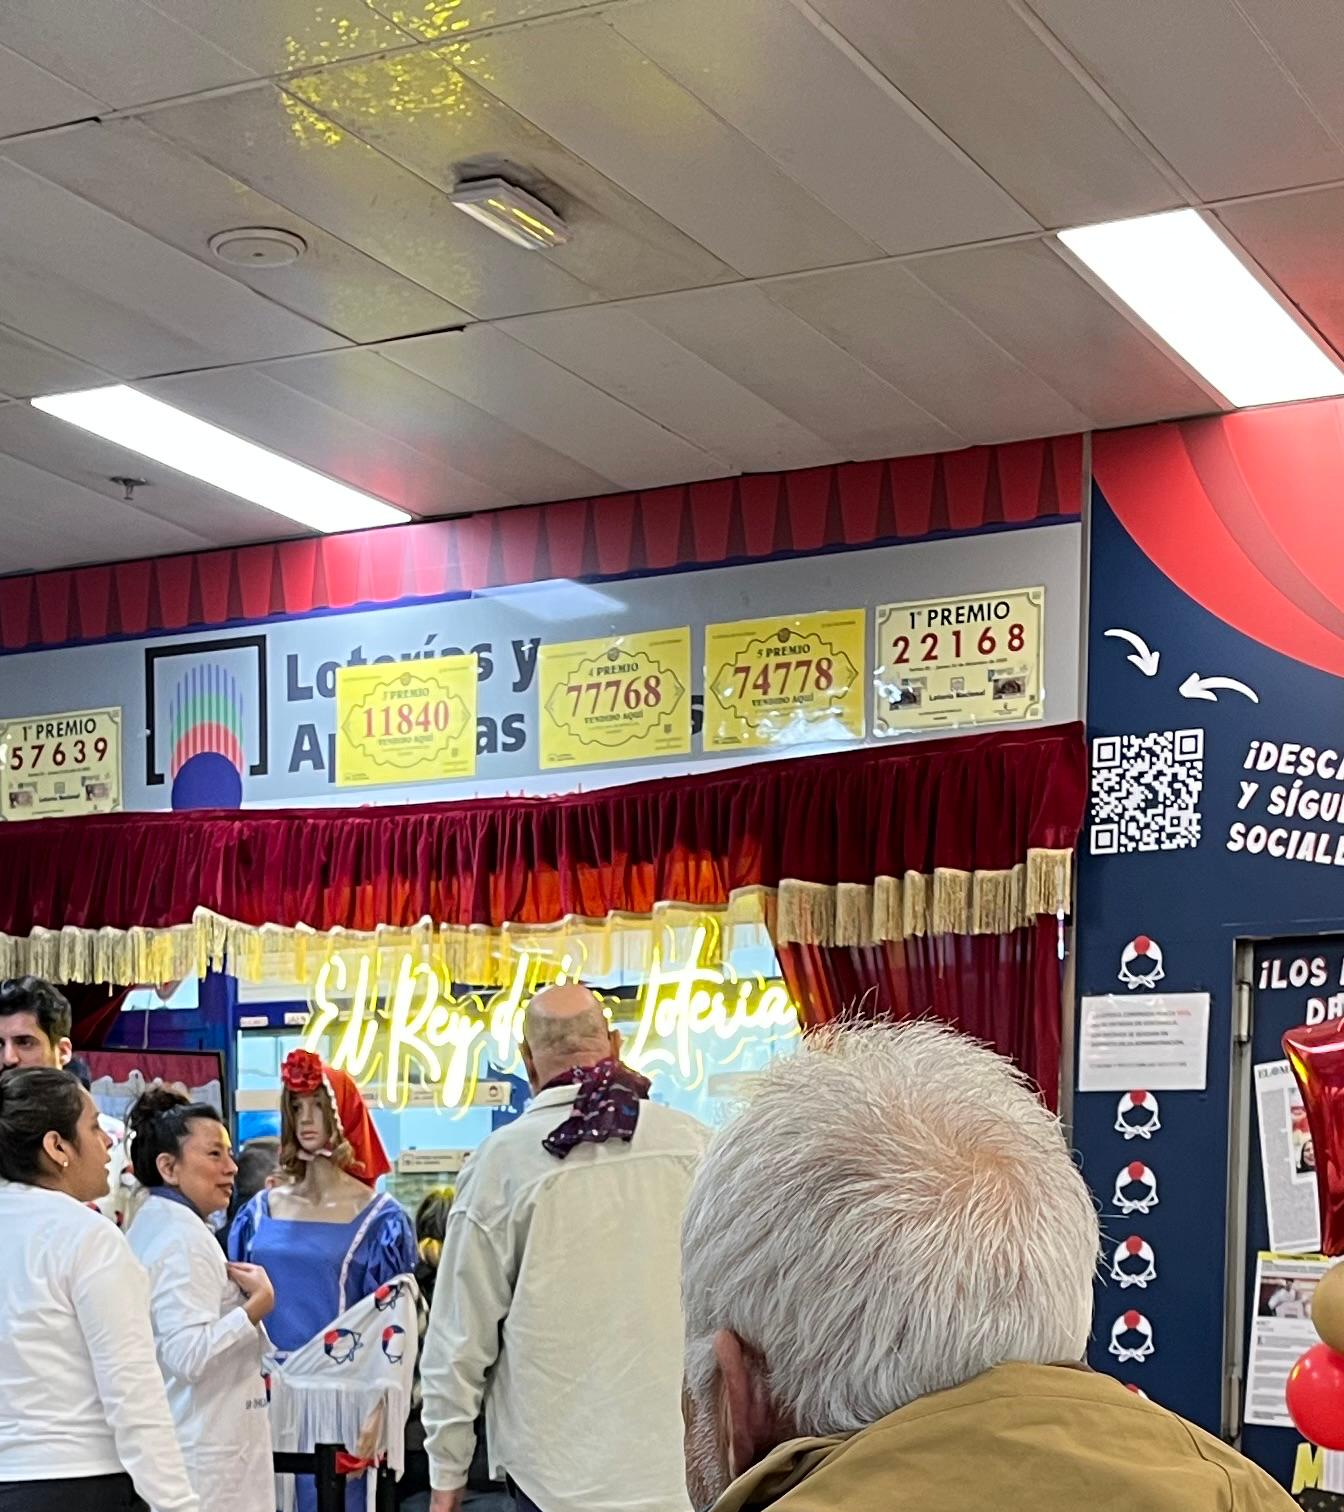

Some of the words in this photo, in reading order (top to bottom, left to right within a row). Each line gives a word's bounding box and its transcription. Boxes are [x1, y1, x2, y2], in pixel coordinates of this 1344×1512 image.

[927, 601, 1010, 628] PREMIO
[766, 644, 811, 658] PREMIO
[892, 623, 1025, 665] 22168
[511, 637, 542, 693] y
[596, 662, 639, 677] PREMIO
[732, 657, 833, 699] 74778
[390, 687, 430, 700] PREMIO
[566, 674, 662, 717] 77768
[36, 718, 97, 740] PREMIO
[363, 699, 450, 738] 11840
[10, 737, 108, 771] 57639
[1236, 780, 1259, 810] Y
[1258, 959, 1328, 989] ¡LOS
[386, 952, 485, 1108] Rey
